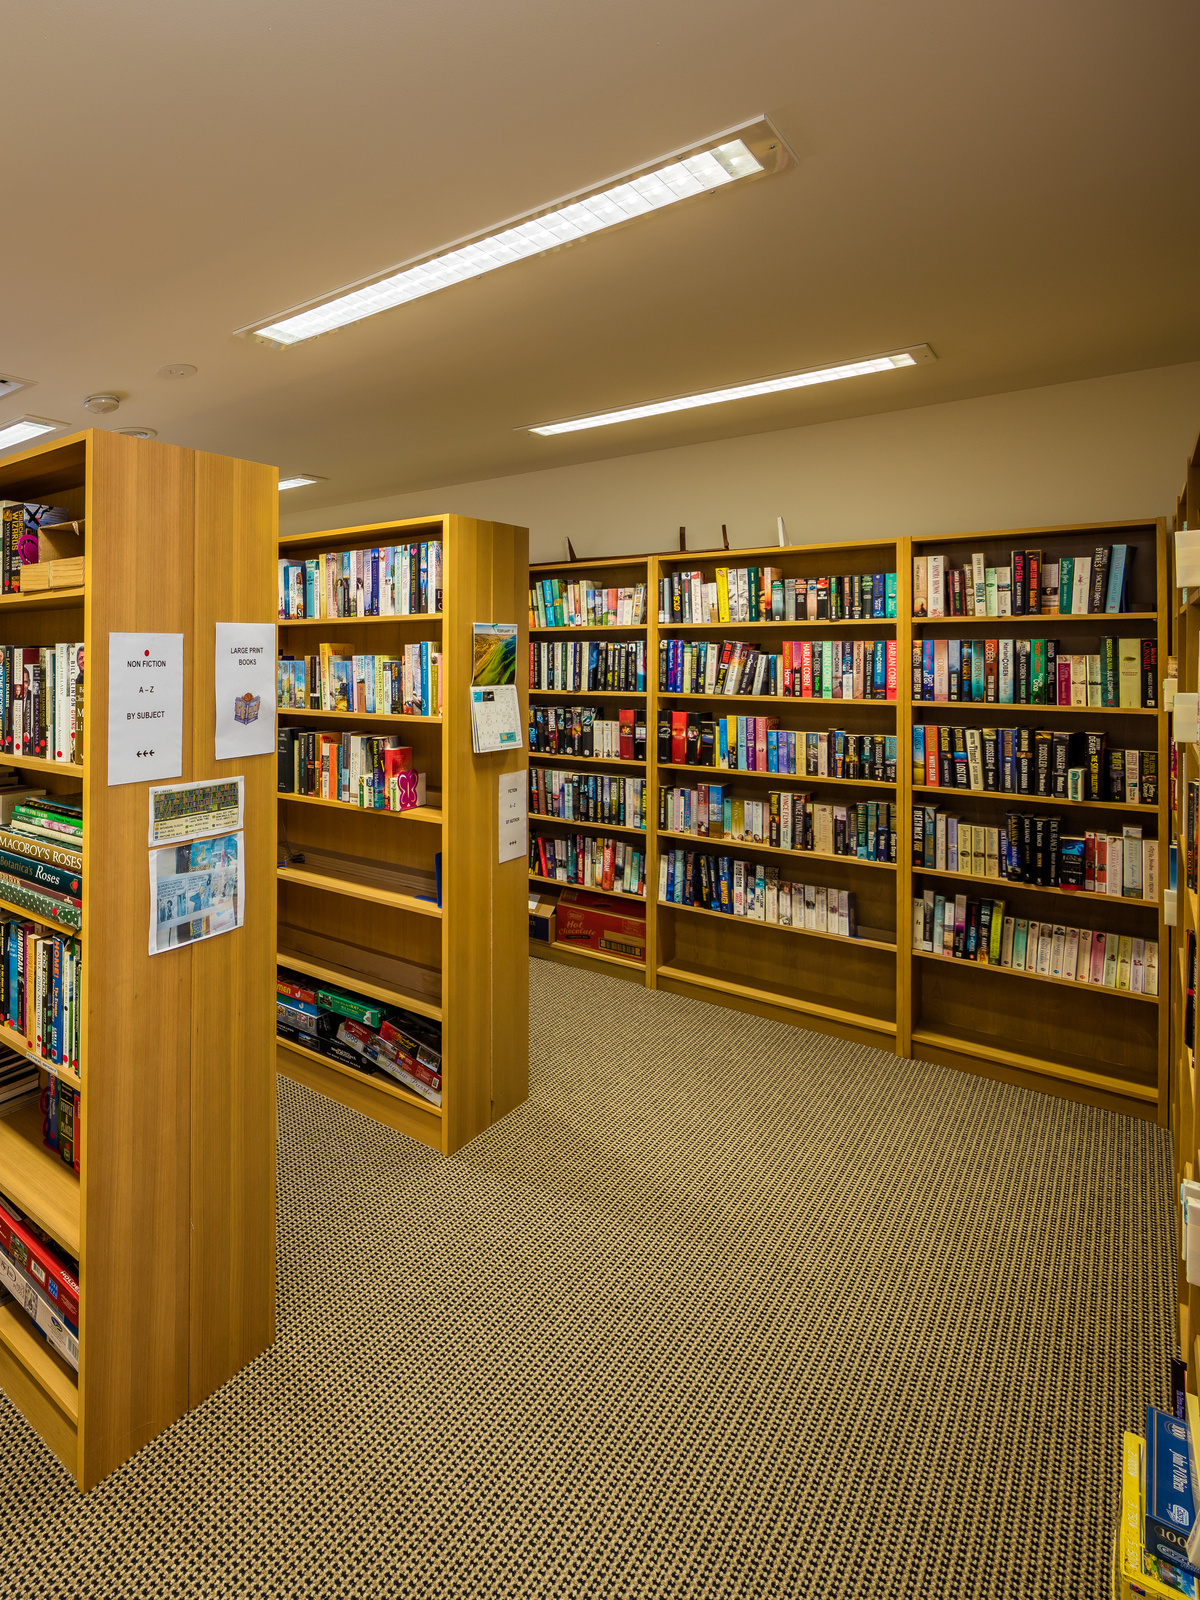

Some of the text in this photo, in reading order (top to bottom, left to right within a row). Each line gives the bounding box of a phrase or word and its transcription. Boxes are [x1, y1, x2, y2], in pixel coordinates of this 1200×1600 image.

[11, 511, 19, 551] WIZARDS
[1094, 547, 1104, 568] BYRNES
[1112, 548, 1124, 572] Liz Byrski
[931, 564, 940, 595] SANDRA BROWN
[127, 660, 167, 668] NON FICTION
[803, 643, 811, 686] HARLAN COBEN
[888, 642, 897, 688] HARLAN COBEN
[924, 641, 933, 671] Harlan Coben
[985, 642, 995, 664] COBEN
[1034, 641, 1043, 673] Harlan Coben
[1143, 641, 1152, 670] CONNELLY
[784, 669, 792, 685] Home
[813, 657, 821, 676] COBEN
[138, 686, 145, 694] A
[137, 711, 165, 719] SUBJECT
[914, 727, 923, 750] CLIVE CUSSLER
[940, 727, 950, 752] CLIVE CUSSLER
[955, 729, 964, 752] CLIVE CUSSLER
[1004, 730, 1013, 757] CLIVE CUSSLER
[1088, 735, 1097, 755] DEAVER
[986, 743, 995, 763] CUSSLER
[1038, 746, 1048, 768] CUSSLER
[1056, 746, 1066, 769] CUSSLER
[1111, 752, 1122, 770] DEAVER
[928, 755, 936, 782] WHITE DEATH
[956, 763, 966, 784] LOST CITY
[1090, 754, 1099, 794] THE SKIN COLLECTOR
[1126, 751, 1138, 780] JEFFERY DEAVER
[1148, 783, 1157, 798] Jeffery
[795, 799, 804, 832] VINCE FLYNN
[913, 809, 923, 852] DEATH MASK FOX
[1049, 821, 1059, 851] DICK FRANCIS
[0, 836, 82, 870] MACOBOY'S ROSES
[0, 856, 60, 885] Botanica's Roses
[558, 927, 597, 936] Chocolate
[566, 920, 584, 929] Hot
[52, 940, 60, 978] HOME!
[386, 1060, 433, 1097] Jigsaw Puzzle
[1171, 1423, 1186, 1441] 1000
